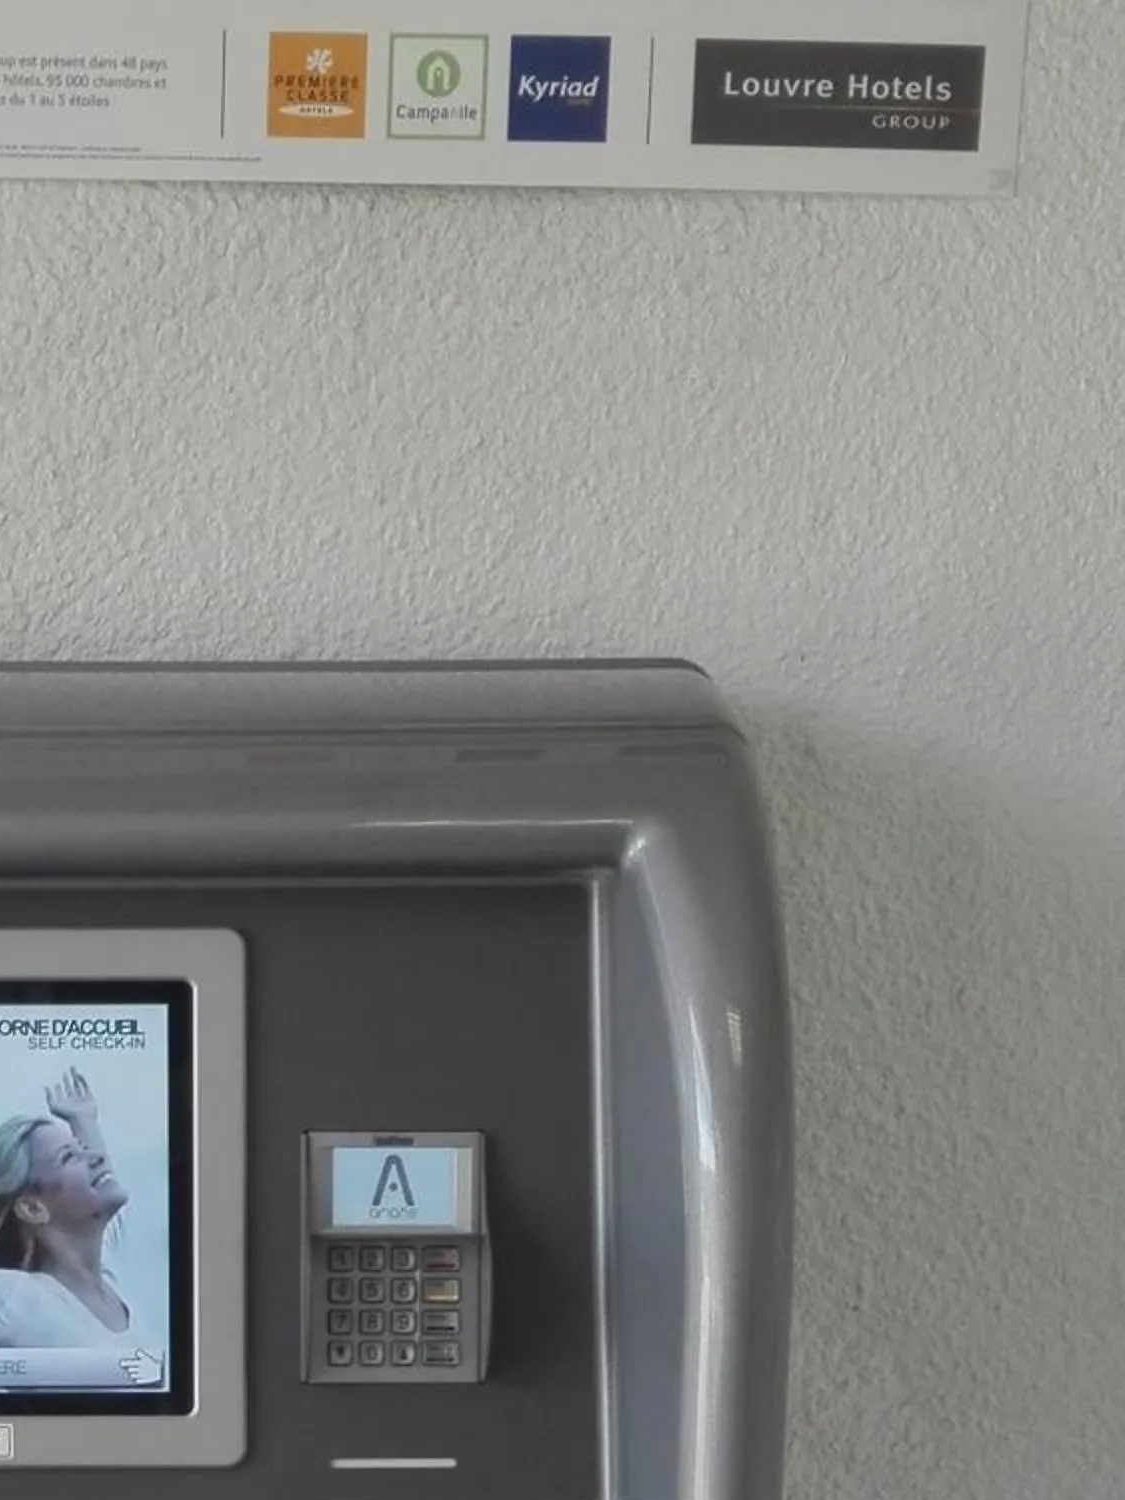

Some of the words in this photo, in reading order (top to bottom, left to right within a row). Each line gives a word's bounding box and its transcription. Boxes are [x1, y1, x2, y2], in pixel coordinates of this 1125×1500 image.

[89, 56, 117, 69] dans
[140, 58, 167, 72] pays
[65, 75, 89, 88] 000
[92, 76, 151, 89] chambres
[517, 74, 600, 102] Kyriad
[724, 71, 834, 98] Louvre
[848, 73, 952, 102] Hotels
[286, 89, 349, 102] CLASSE
[395, 104, 478, 124] Campanile
[872, 113, 951, 130] GROUP
[52, 1019, 145, 1036] D'ACCUEIL
[28, 1037, 67, 1050] SELF
[70, 1036, 146, 1050] CHECK-IN
